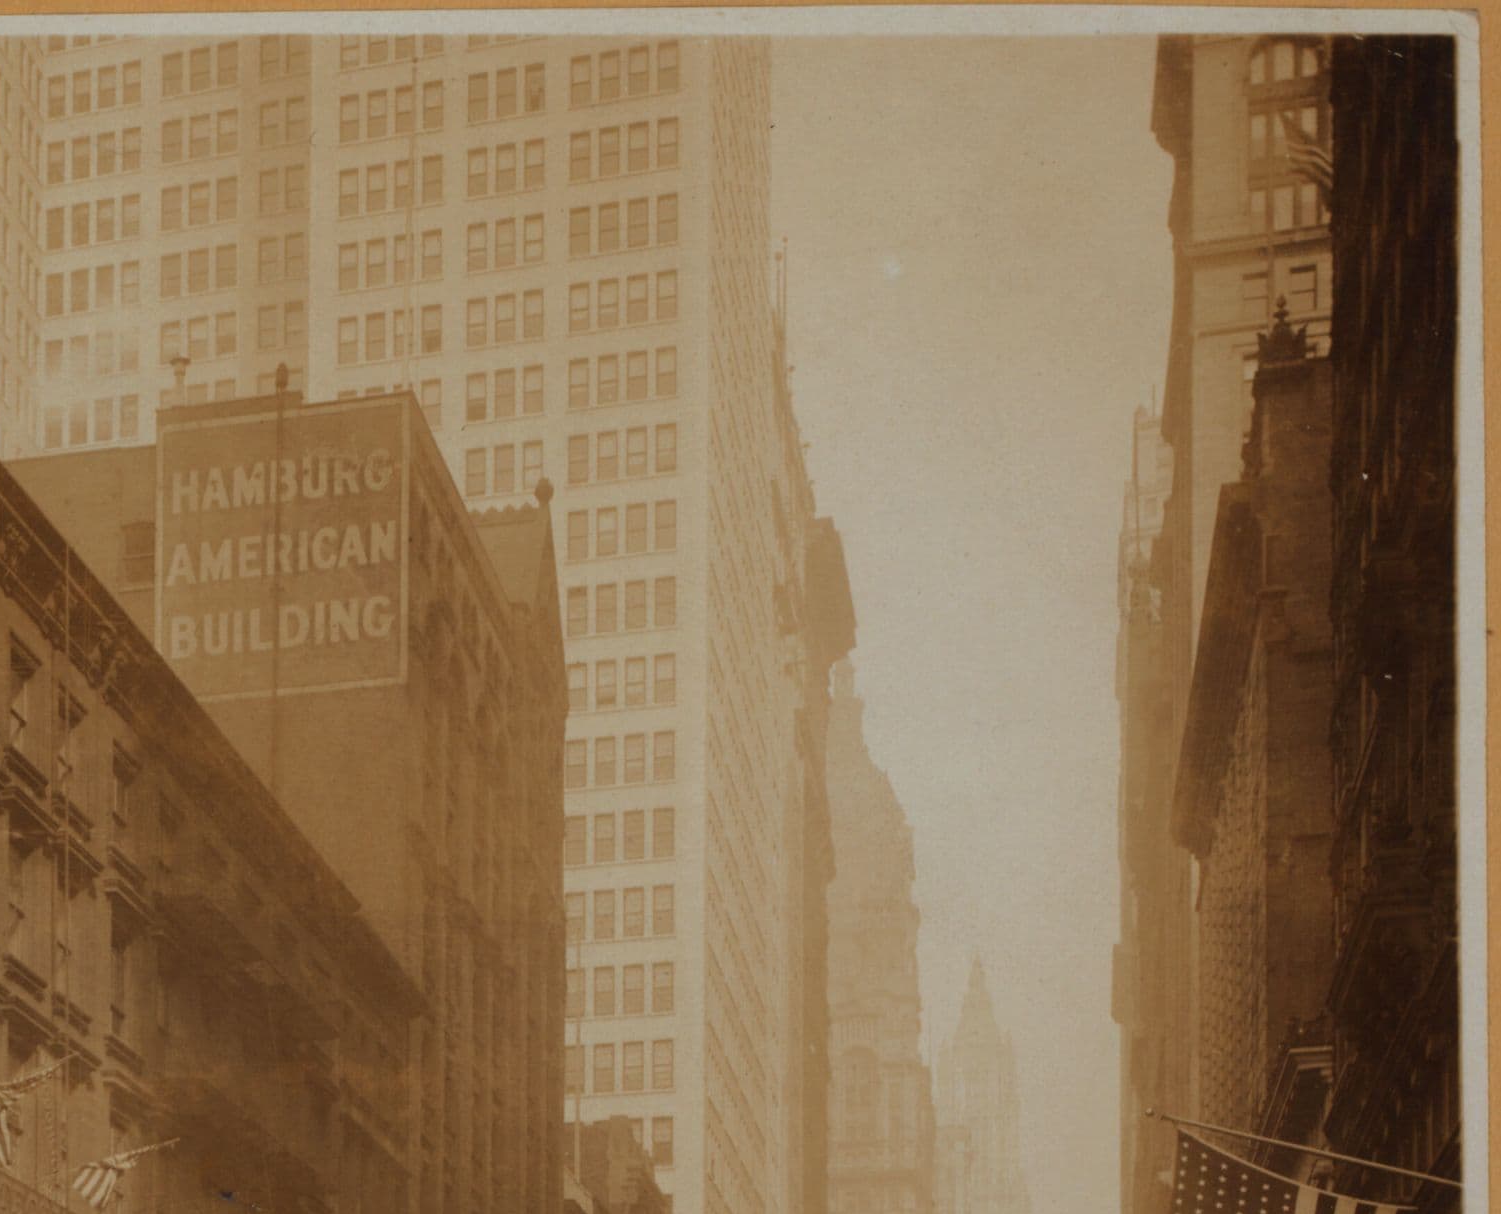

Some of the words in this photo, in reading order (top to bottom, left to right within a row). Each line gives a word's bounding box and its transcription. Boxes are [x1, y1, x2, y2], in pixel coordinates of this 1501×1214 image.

[171, 448, 393, 514] HAMBURG
[166, 520, 396, 586] AMERICAN
[171, 596, 395, 659] BUILDING
